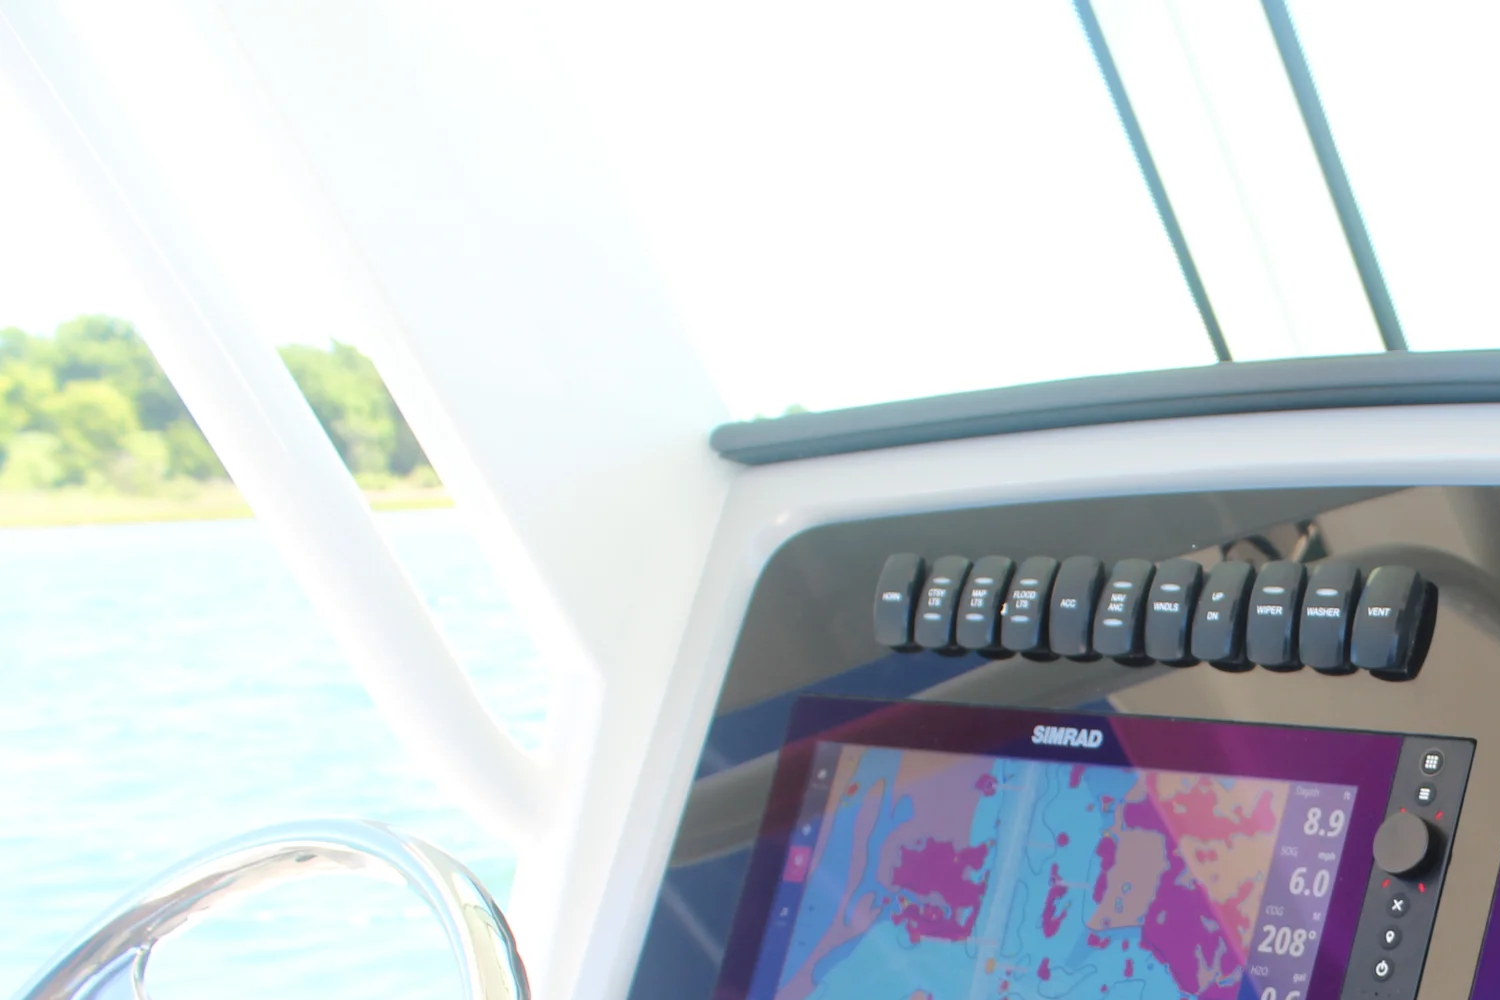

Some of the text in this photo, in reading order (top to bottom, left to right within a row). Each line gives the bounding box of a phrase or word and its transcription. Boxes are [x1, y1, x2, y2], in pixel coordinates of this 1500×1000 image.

[882, 592, 901, 601] HORN
[972, 589, 988, 598] MAP
[1012, 591, 1036, 600] FLOOD
[1110, 594, 1126, 602] NAV
[1212, 592, 1224, 601] UP
[928, 598, 941, 607] LTS
[970, 598, 983, 607] LTS
[1015, 600, 1029, 609] LTS
[1060, 599, 1076, 609] ACC
[1108, 602, 1124, 612] ANC
[1256, 605, 1283, 615] WIPER
[1306, 607, 1340, 617] WASHER
[1368, 607, 1391, 617] VENT
[1207, 611, 1219, 621] DN
[1031, 725, 1103, 748] SIMRAD
[1303, 807, 1345, 838] 8.9
[1289, 866, 1330, 898] 6.0
[1257, 924, 1316, 957] 208°
